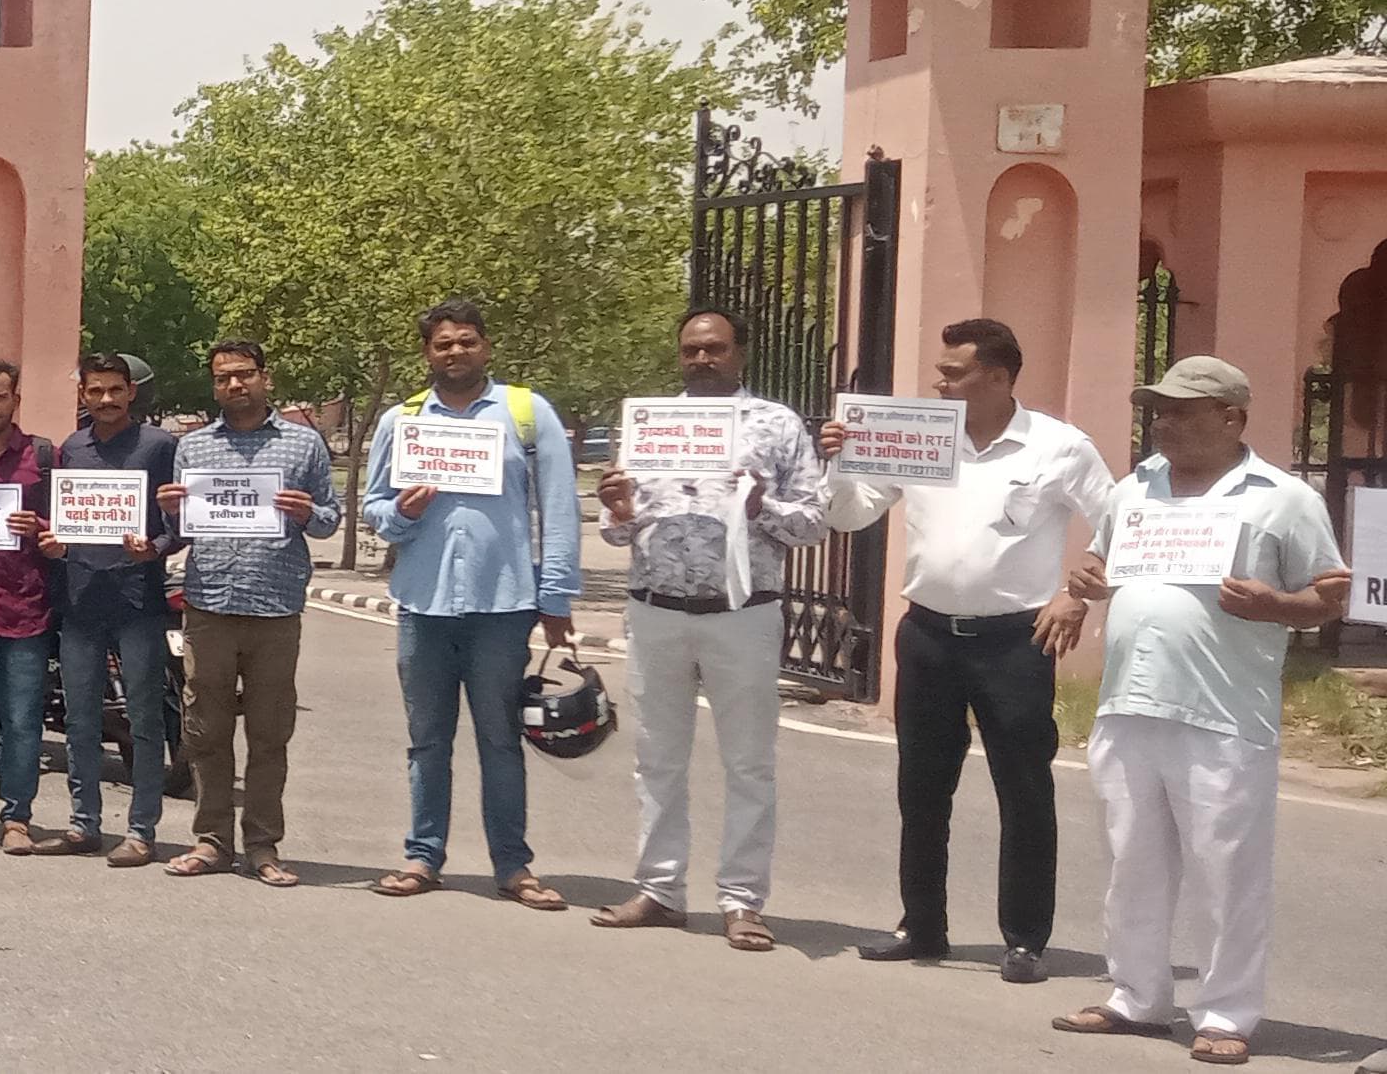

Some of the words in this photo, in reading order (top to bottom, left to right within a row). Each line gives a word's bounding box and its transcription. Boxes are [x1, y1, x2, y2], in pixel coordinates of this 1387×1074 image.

[905, 432, 922, 445] को
[925, 435, 953, 447] RTE
[407, 443, 445, 457] शिक्षा
[449, 448, 489, 460] हमारा
[855, 446, 871, 456] का
[874, 446, 923, 460] अधिकार
[926, 448, 939, 462] दो
[417, 459, 476, 473] अधिकार
[212, 478, 239, 487] शिक्षा
[240, 478, 250, 487] दो
[61, 496, 75, 506] हम
[124, 494, 136, 507] भी
[205, 489, 239, 506] नहीं
[239, 490, 260, 506] तो
[92, 509, 117, 521] करनी
[245, 510, 255, 519] दो
